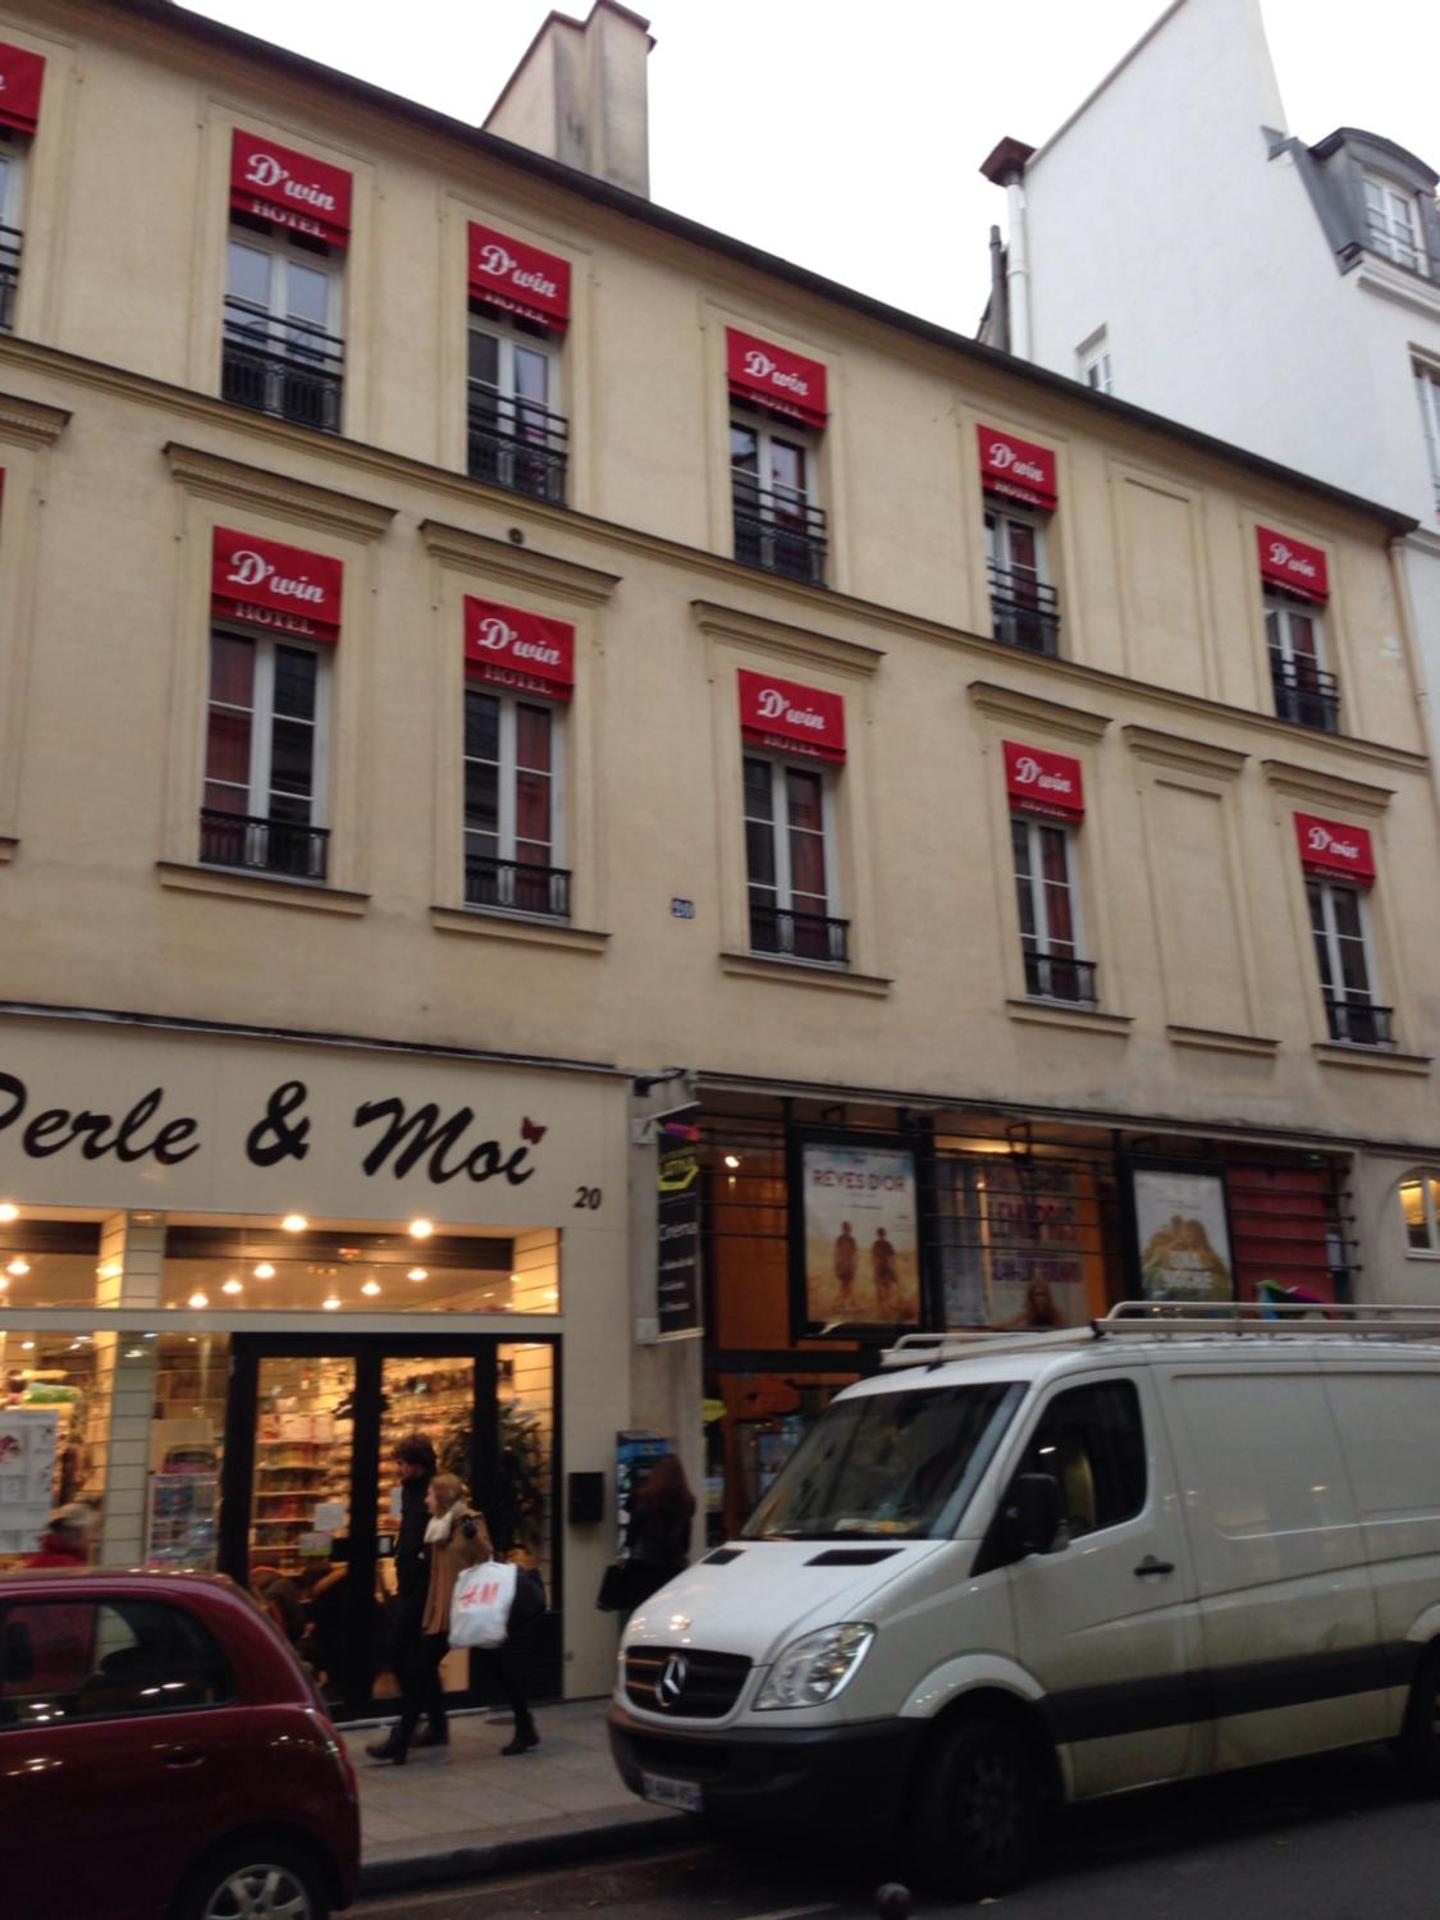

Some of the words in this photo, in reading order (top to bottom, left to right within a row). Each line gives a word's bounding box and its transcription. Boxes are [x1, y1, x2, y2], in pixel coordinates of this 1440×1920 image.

[245, 153, 336, 211] D'win
[252, 199, 327, 238] HOTEL
[478, 244, 556, 298] D'win
[743, 350, 808, 396] D'win
[226, 550, 325, 603] D'win
[236, 601, 315, 634] HOTEL
[477, 618, 562, 665] D'win
[757, 688, 826, 730] D'win
[246, 1080, 311, 1167] &
[354, 1096, 546, 1186] Moi
[573, 1185, 602, 1211] 20
